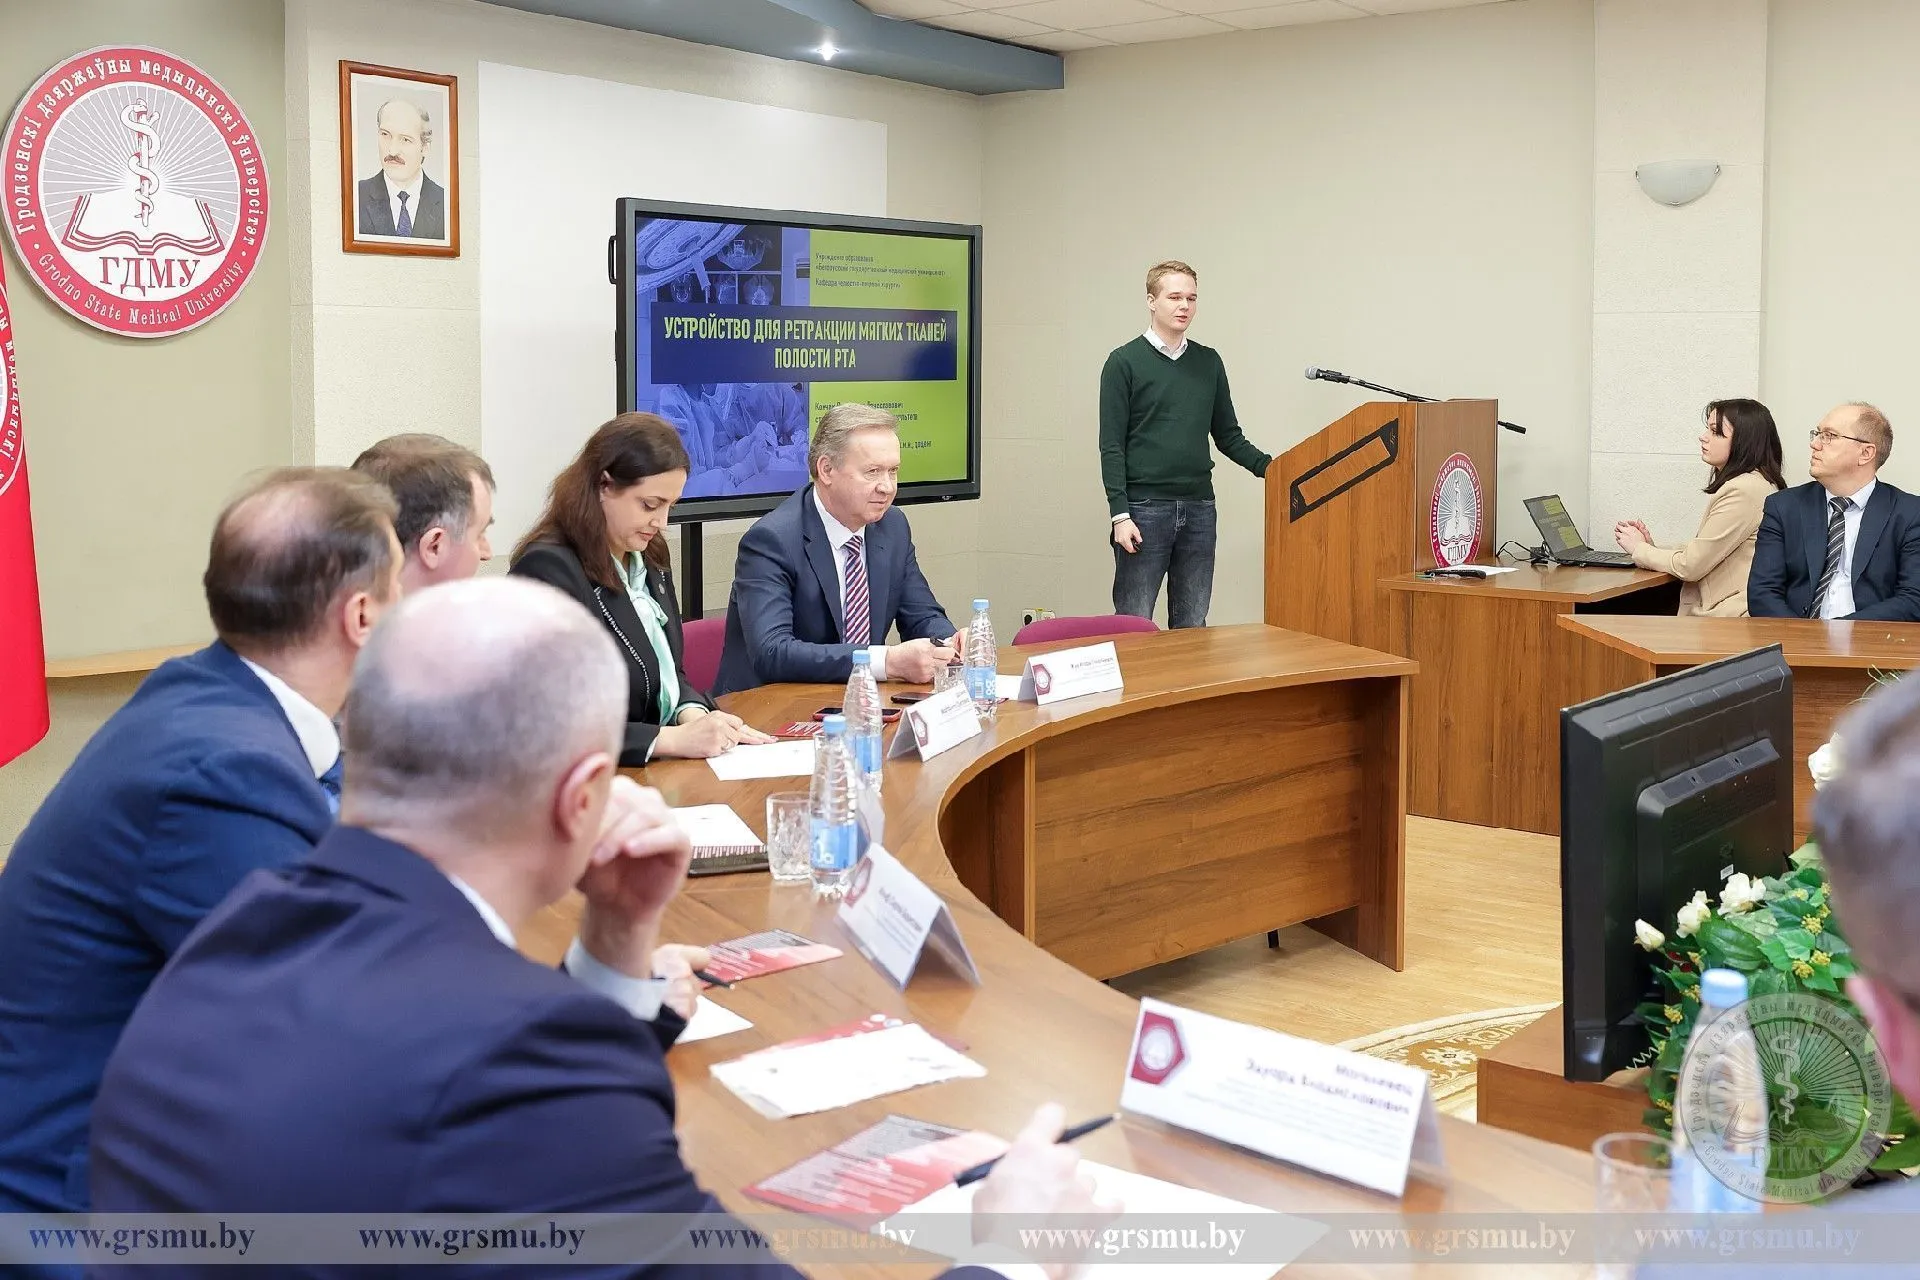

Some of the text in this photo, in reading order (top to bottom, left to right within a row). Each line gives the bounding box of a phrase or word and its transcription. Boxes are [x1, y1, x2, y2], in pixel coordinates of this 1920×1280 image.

[14, 57, 264, 246] Гродзенскі дзяржаўны медыцынскі ўніверсітэт
[37, 252, 245, 326] Grodno State Medical University
[99, 256, 201, 297] ГДМУ
[664, 313, 947, 344] УСТРОЙСТВО ДЛЯ РЕТРАКЦИИ МЯГКИХ ТКАНЕЙ
[774, 347, 856, 369] ПОЛОСТИ РТА
